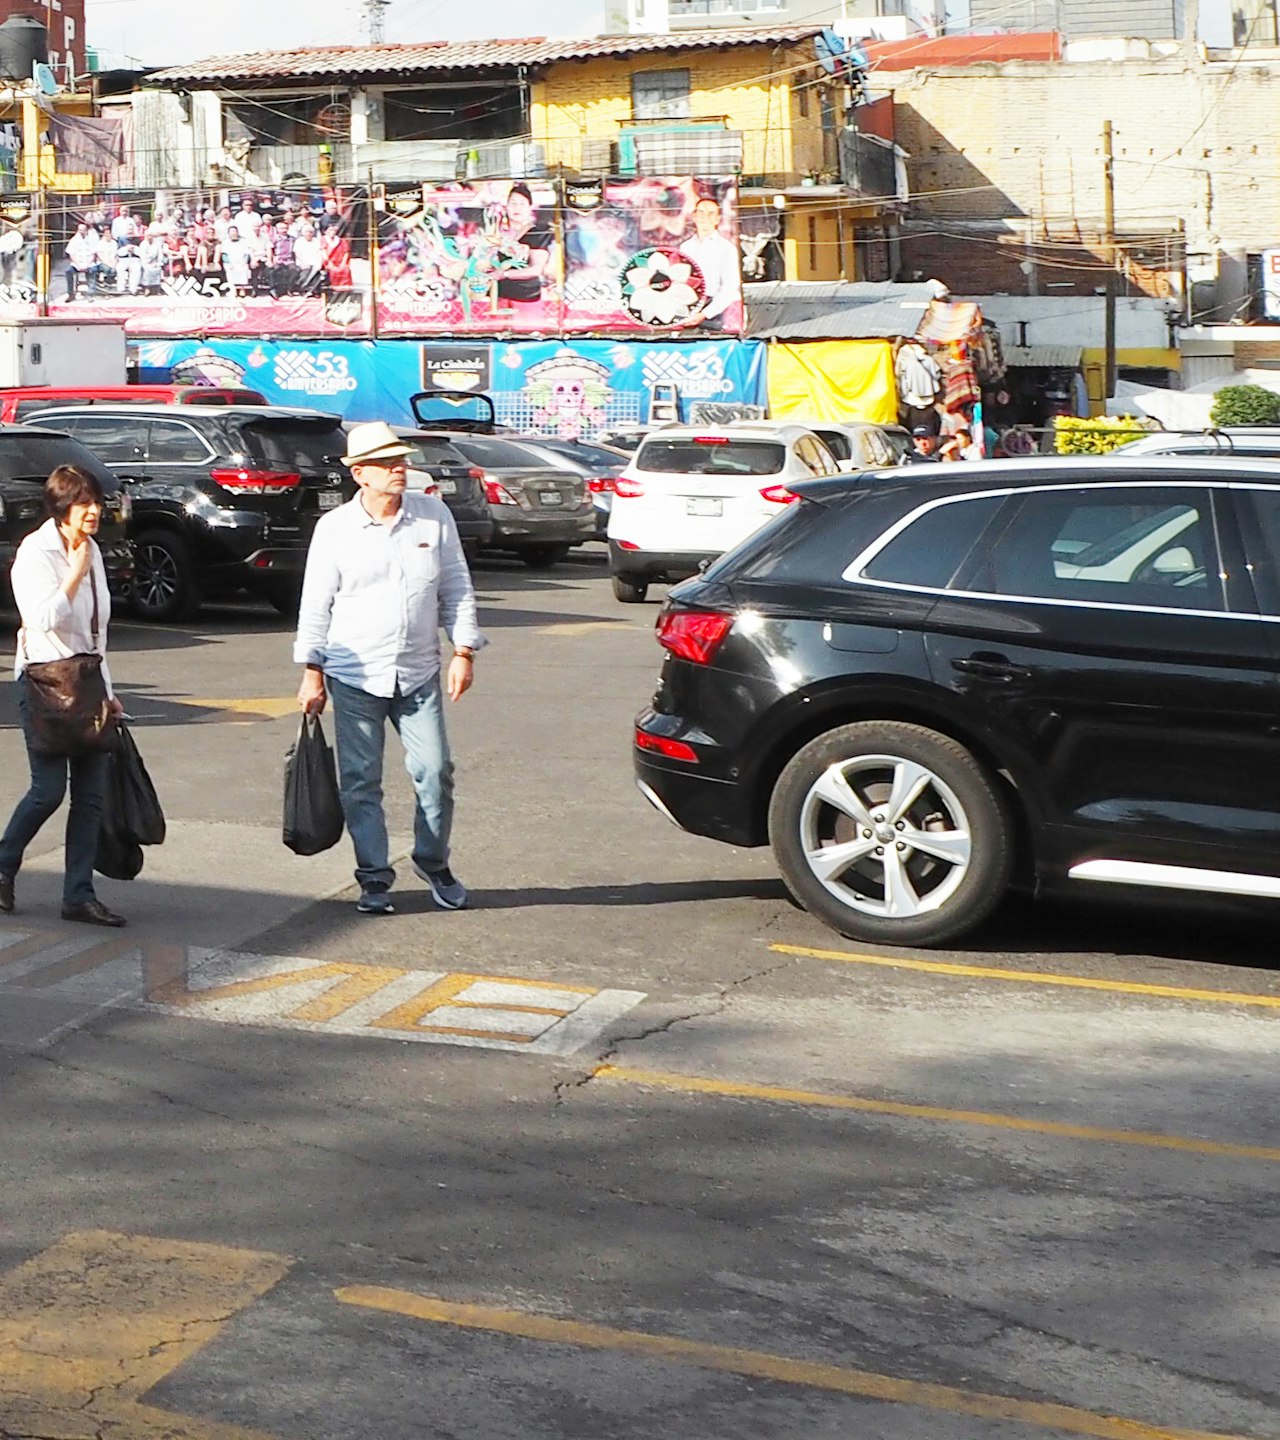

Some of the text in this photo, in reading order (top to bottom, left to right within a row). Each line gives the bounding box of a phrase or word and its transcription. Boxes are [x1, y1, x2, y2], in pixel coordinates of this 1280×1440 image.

[314, 351, 348, 378] 53
[427, 360, 441, 370] La
[684, 350, 724, 380] 53
